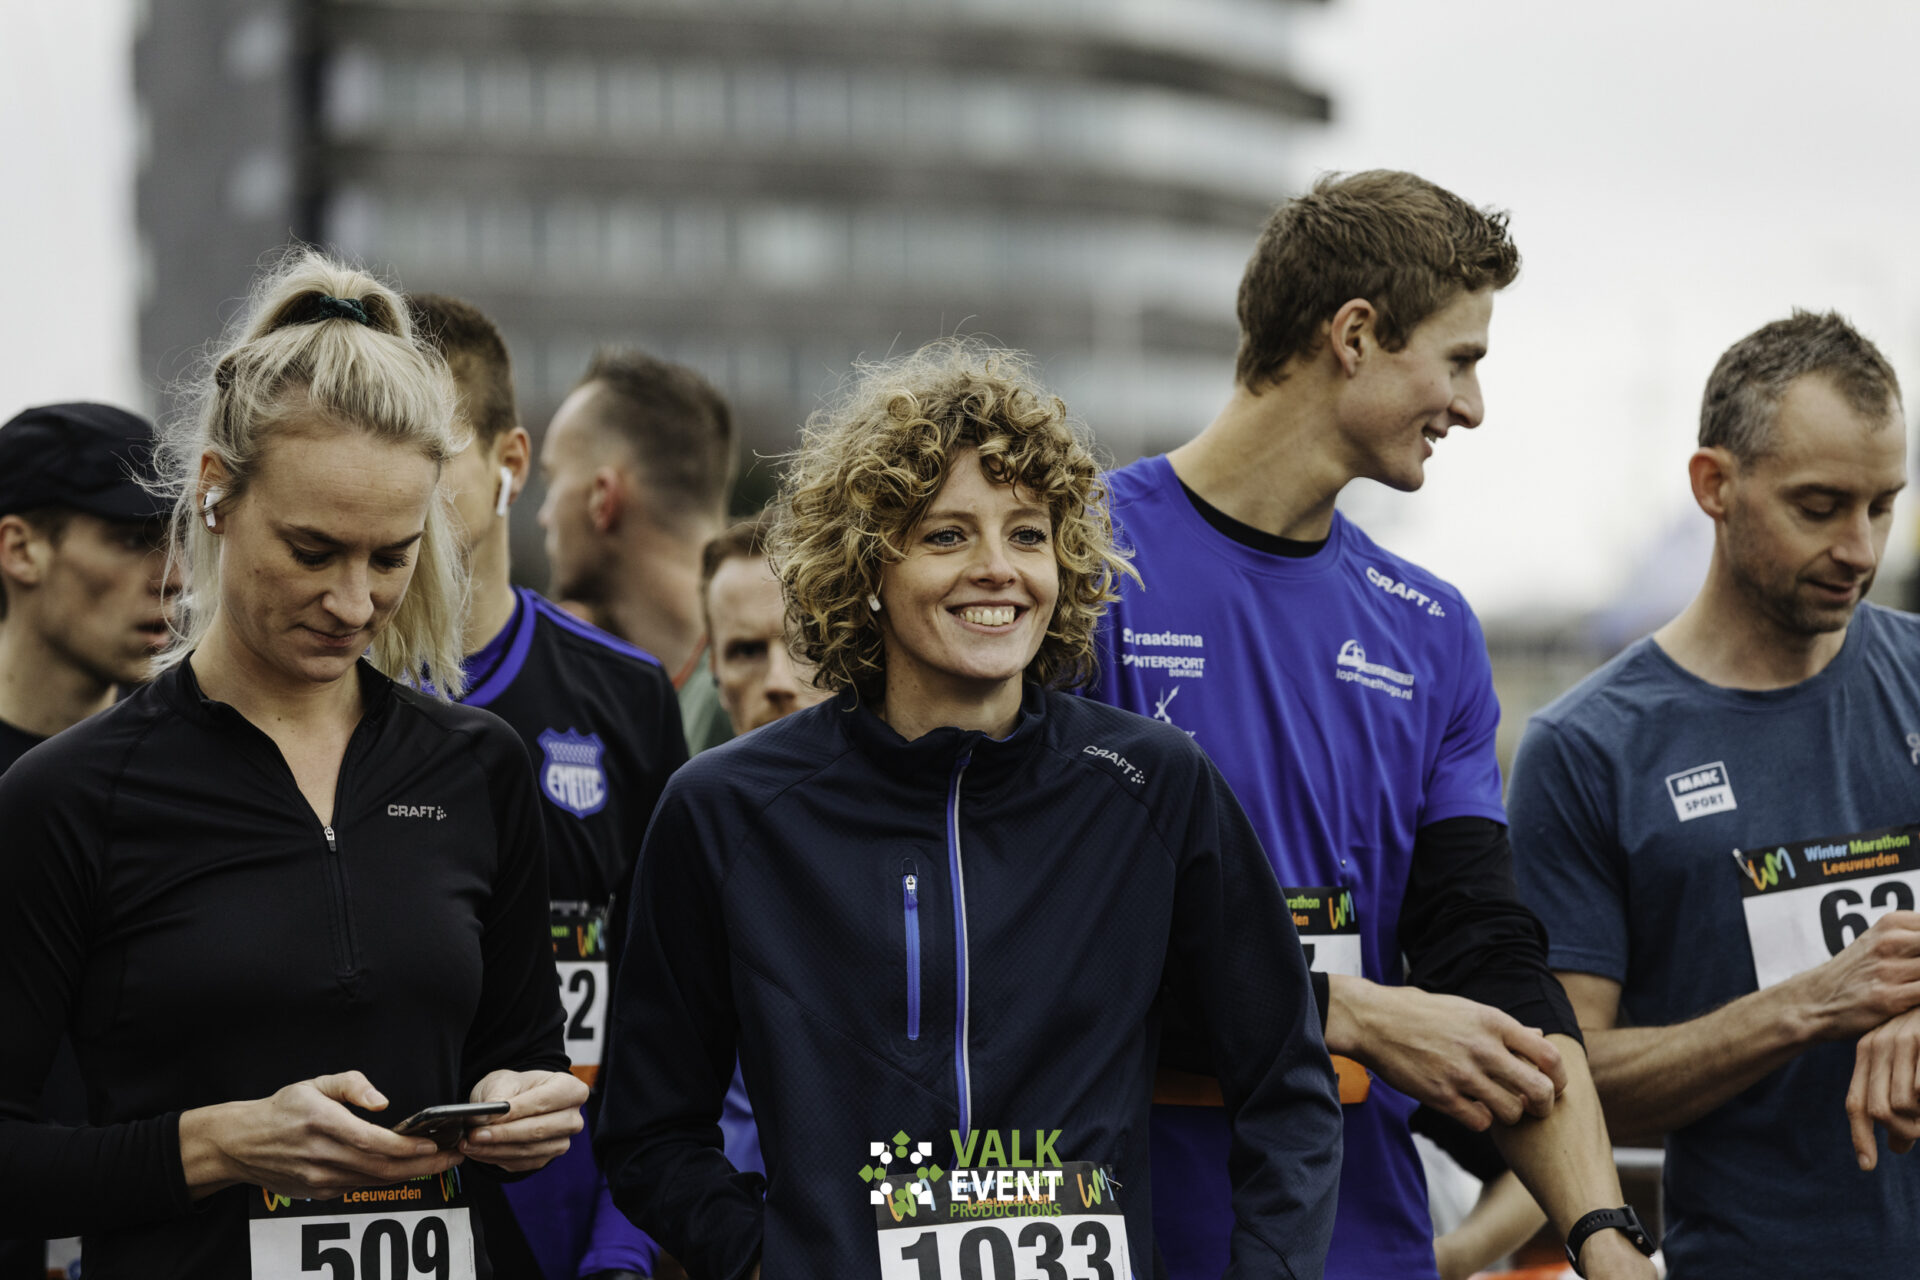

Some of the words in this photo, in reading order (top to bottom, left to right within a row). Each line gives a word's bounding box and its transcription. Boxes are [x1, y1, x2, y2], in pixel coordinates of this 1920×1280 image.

[1366, 566, 1431, 607] CRAFT
[1134, 630, 1204, 648] raadsma
[1083, 745, 1136, 774] CRAFT
[1677, 769, 1720, 793] MARC
[387, 804, 436, 818] CRAFT
[1685, 793, 1724, 813] SPORT
[1804, 843, 1848, 862] Winter
[1849, 834, 1910, 855] Marathon
[1822, 852, 1899, 876] Leeuwarden
[343, 1185, 422, 1203] Leeuwarden
[301, 1216, 450, 1280] 509
[901, 1220, 1115, 1280] 1033
